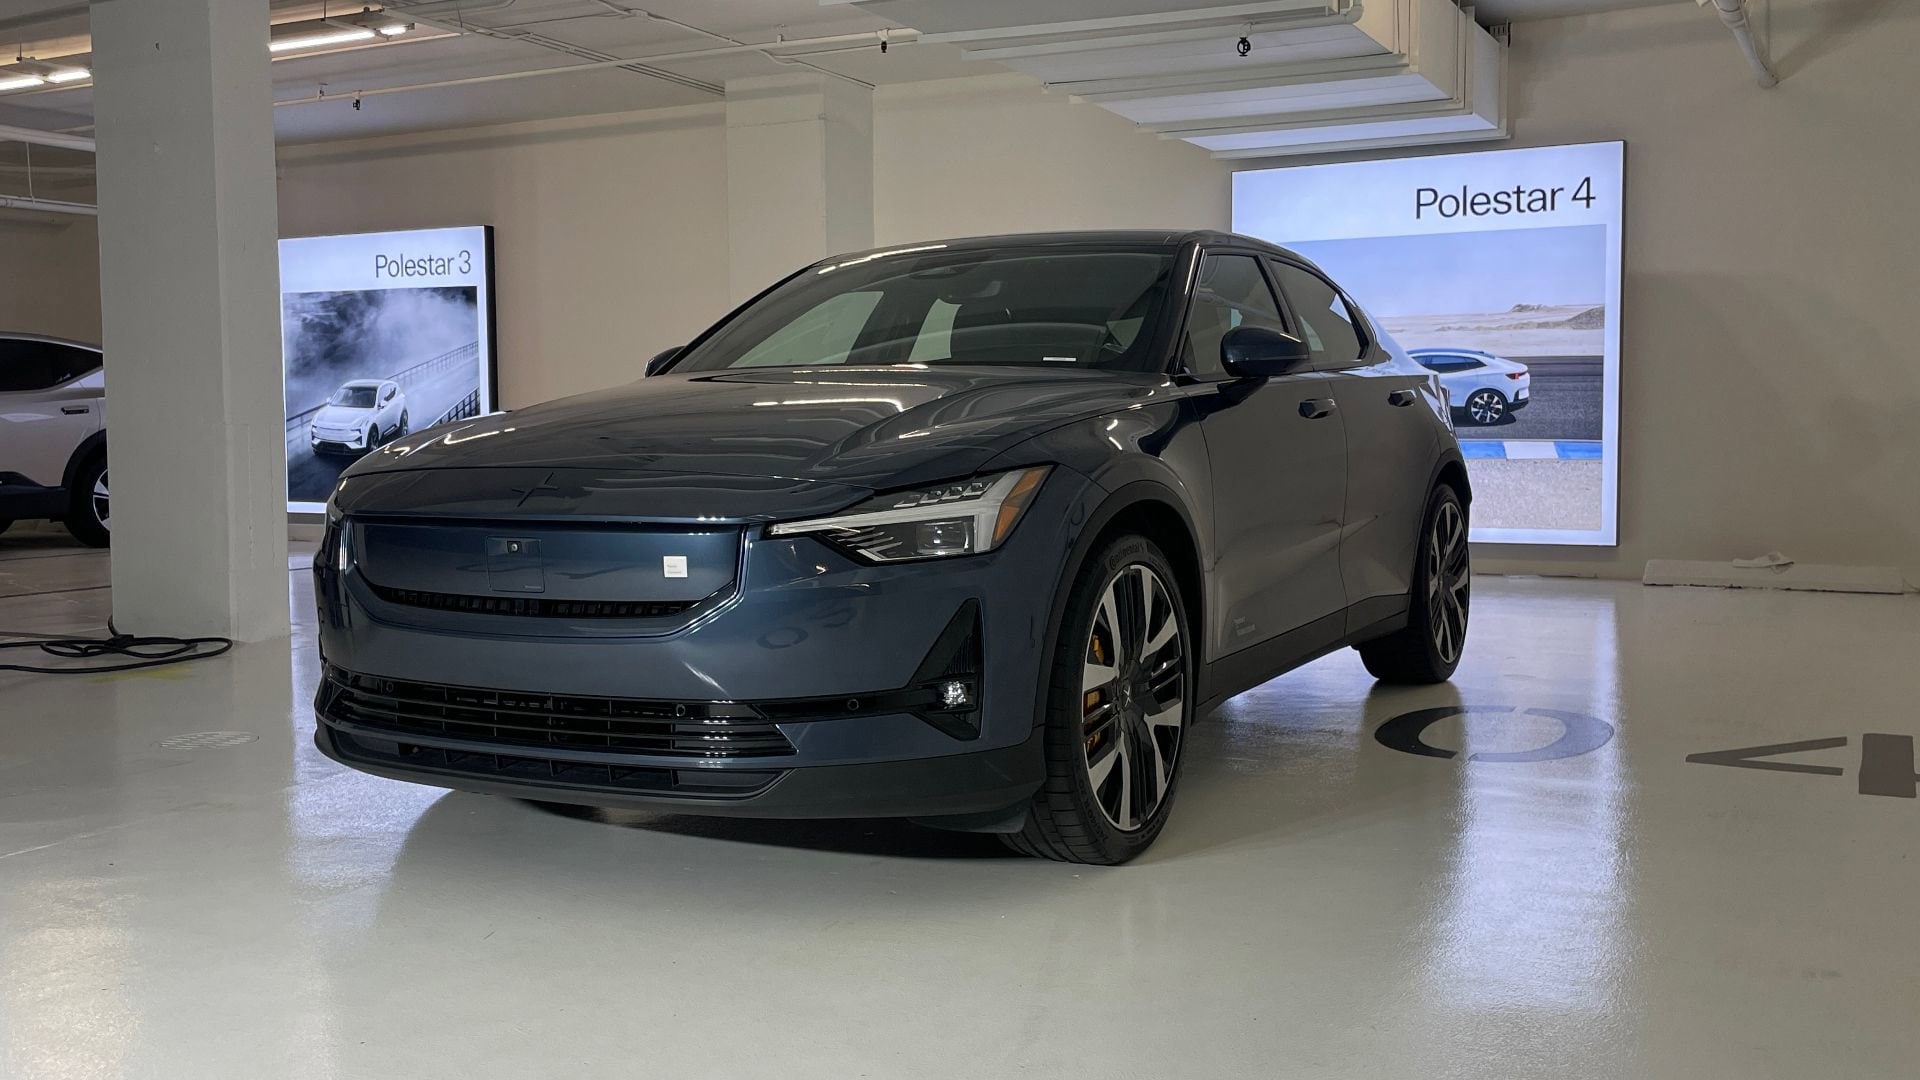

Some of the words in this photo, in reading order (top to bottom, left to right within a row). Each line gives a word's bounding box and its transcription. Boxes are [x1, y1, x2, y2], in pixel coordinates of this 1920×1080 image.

[1416, 185, 1565, 219] Polestar
[1571, 176, 1596, 208] 4
[375, 253, 455, 278] Polestar
[458, 250, 471, 274] 3
[1109, 542, 1140, 571] Continental
